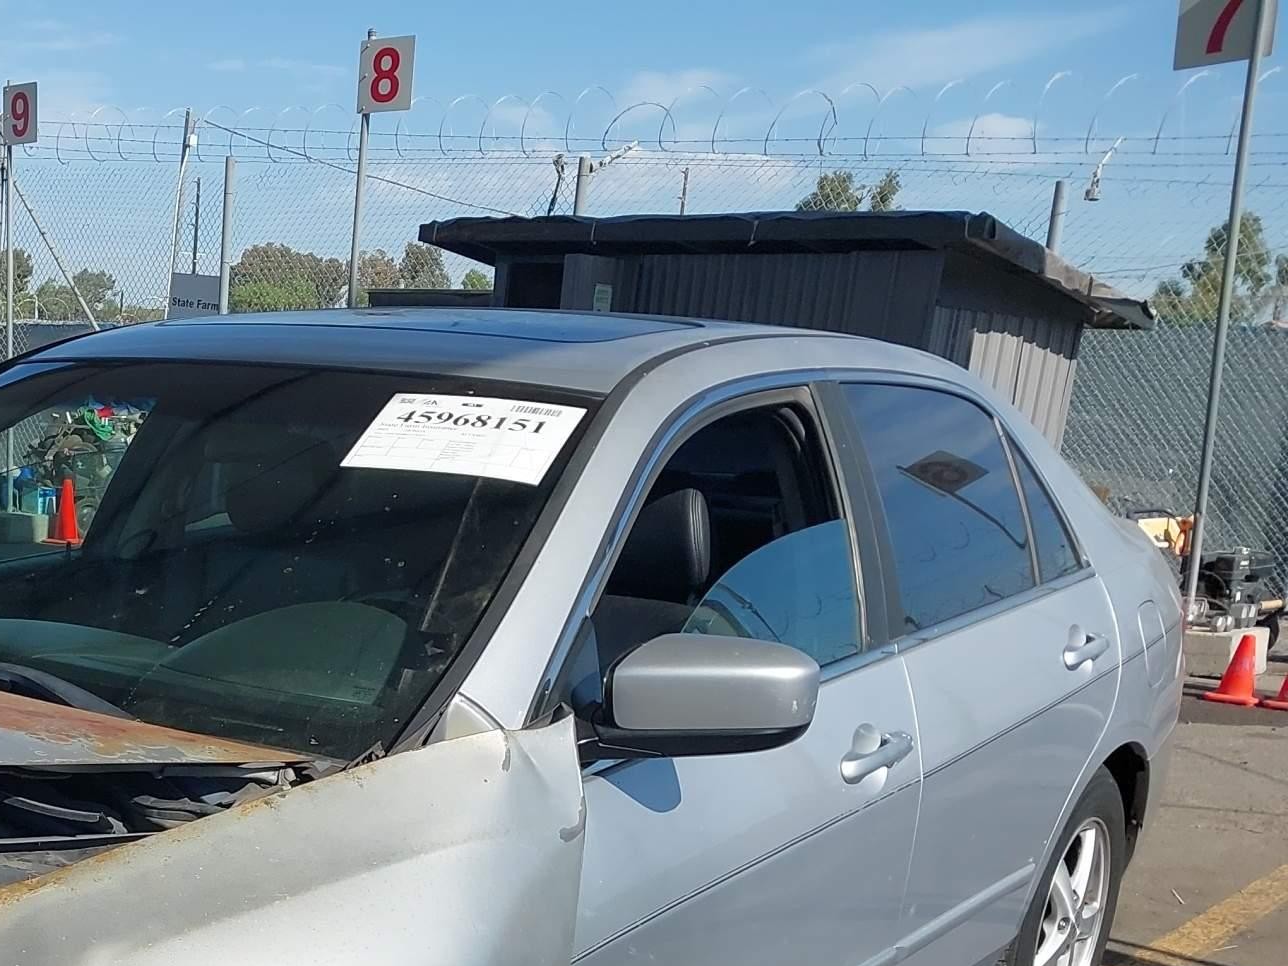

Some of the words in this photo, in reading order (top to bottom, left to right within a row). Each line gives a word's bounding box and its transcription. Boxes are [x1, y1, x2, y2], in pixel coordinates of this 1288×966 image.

[370, 46, 400, 103] 8
[11, 91, 30, 138] 9
[171, 296, 194, 309] State
[196, 299, 220, 311] Farm
[396, 409, 547, 435] 45968151
